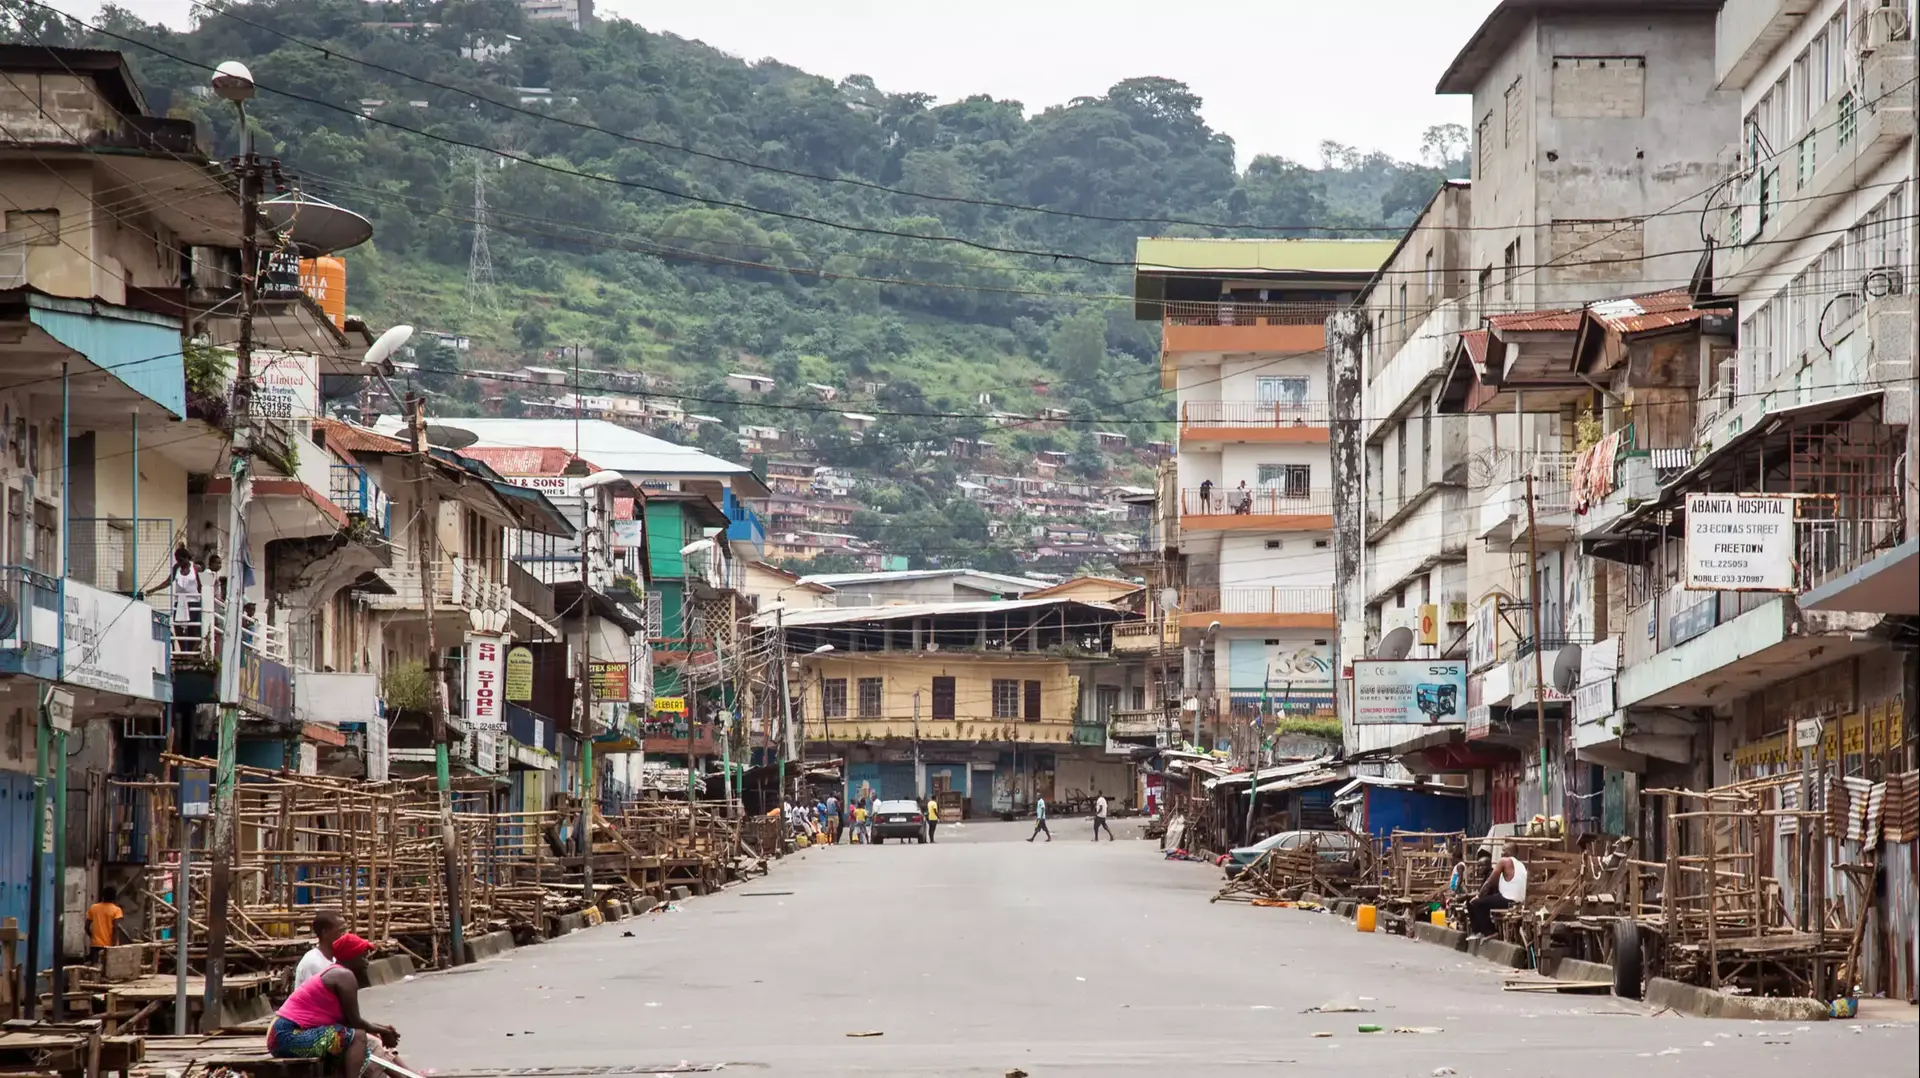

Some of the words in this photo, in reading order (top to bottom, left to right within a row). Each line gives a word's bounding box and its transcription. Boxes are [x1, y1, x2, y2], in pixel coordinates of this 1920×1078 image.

[270, 374, 304, 386] Limited
[520, 479, 528, 487] &
[532, 478, 565, 488] SONS
[1691, 500, 1732, 514] ABANITA
[1737, 500, 1785, 515] HOSPITAL
[1696, 524, 1708, 534] 23
[1709, 524, 1744, 534] ECOWAS
[1746, 524, 1779, 535] STREET
[1714, 543, 1764, 554] FREETOWN
[606, 664, 627, 673] SHOP
[476, 670, 495, 717] STORE
